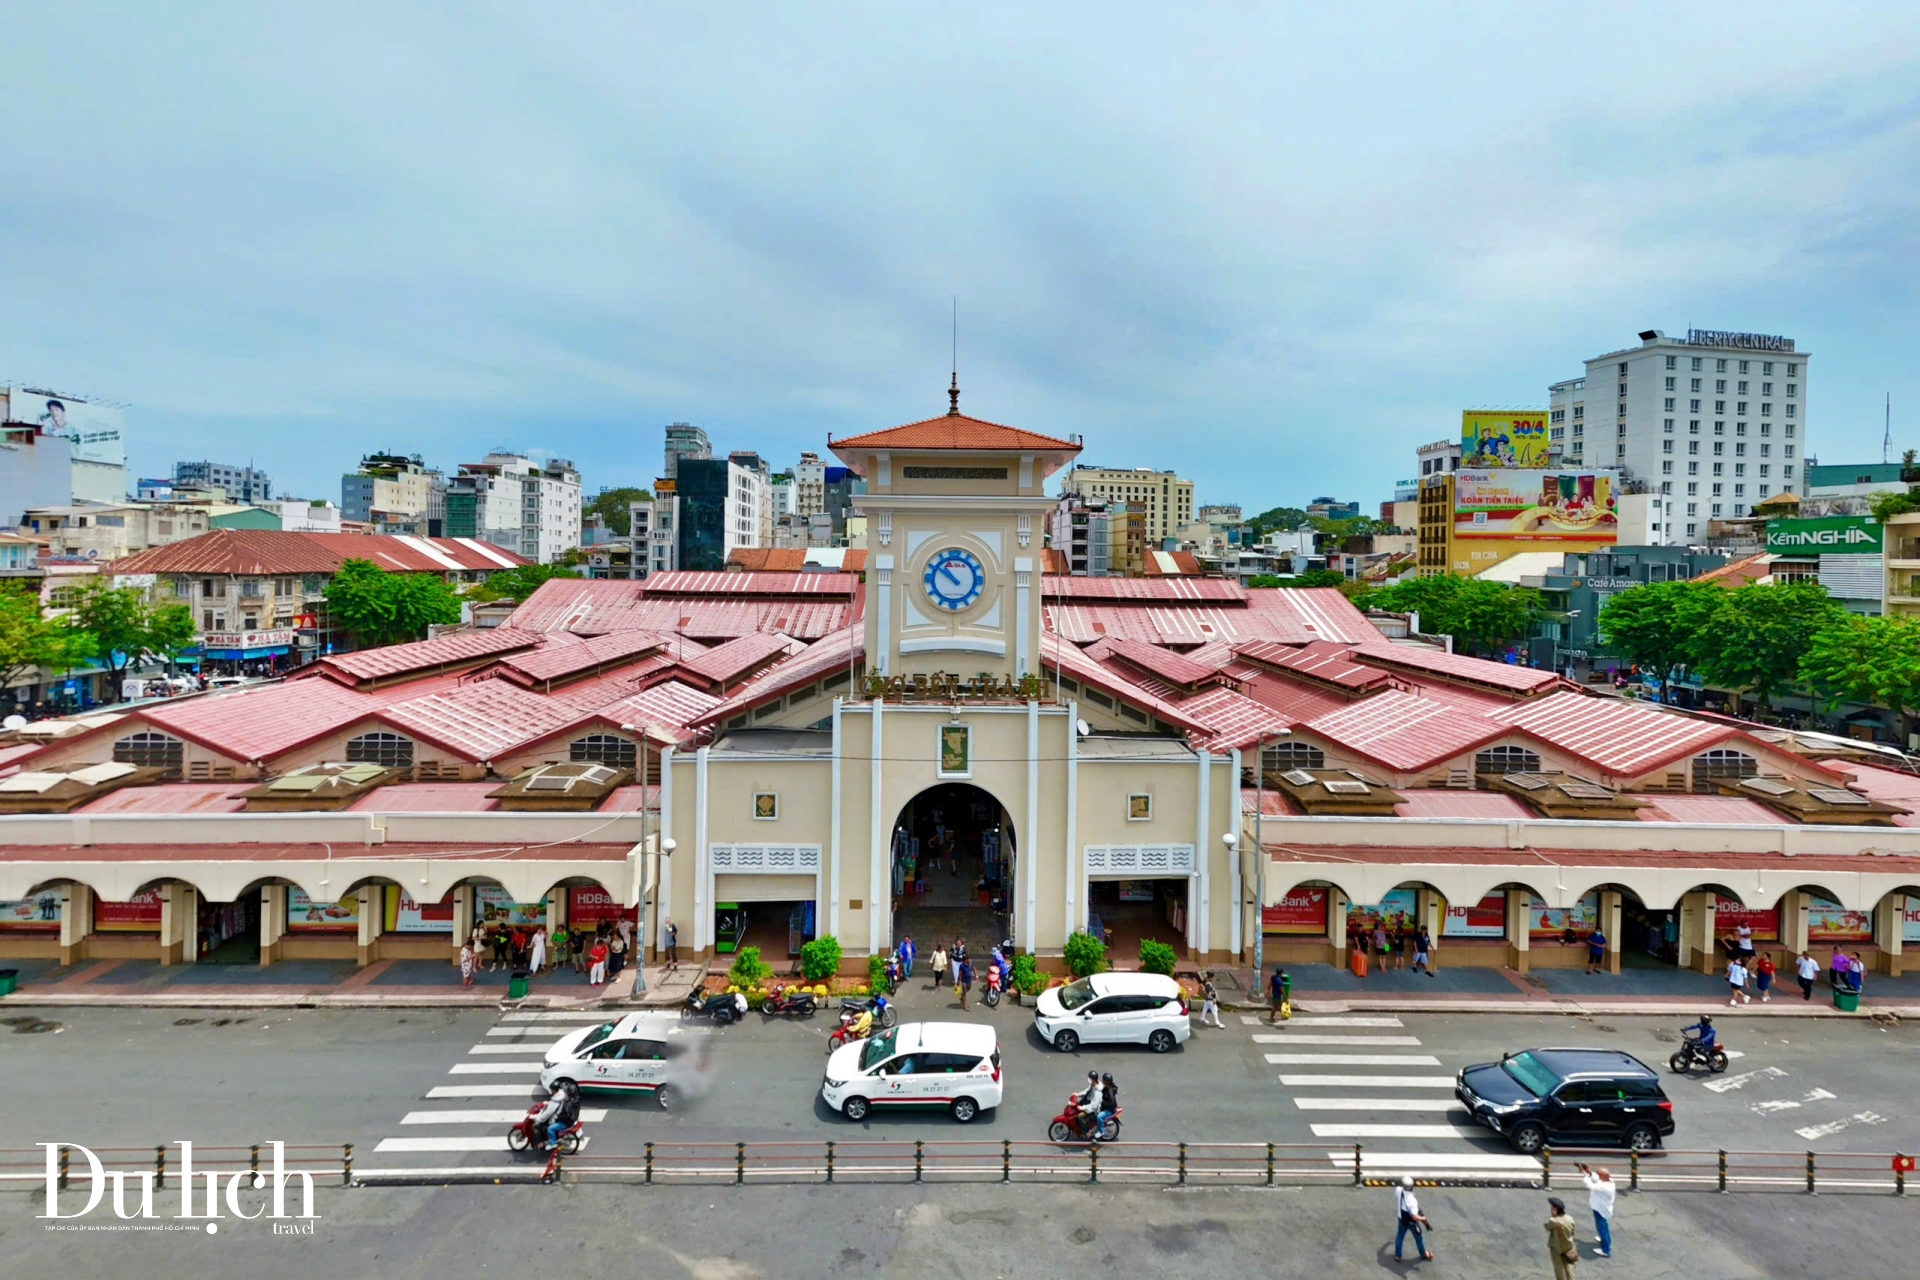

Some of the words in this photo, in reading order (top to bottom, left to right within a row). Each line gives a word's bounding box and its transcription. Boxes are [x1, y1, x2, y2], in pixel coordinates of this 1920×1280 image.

[1513, 420, 1544, 435] 30/4
[1587, 577, 1608, 588] Café
[1609, 579, 1644, 588] Amazon
[258, 632, 271, 642] HÀ
[273, 632, 291, 641] TÂM
[859, 674, 907, 697] CHỢ
[913, 670, 960, 698] BẾN
[967, 674, 1051, 698] THÀNH
[577, 893, 613, 904] HDBa
